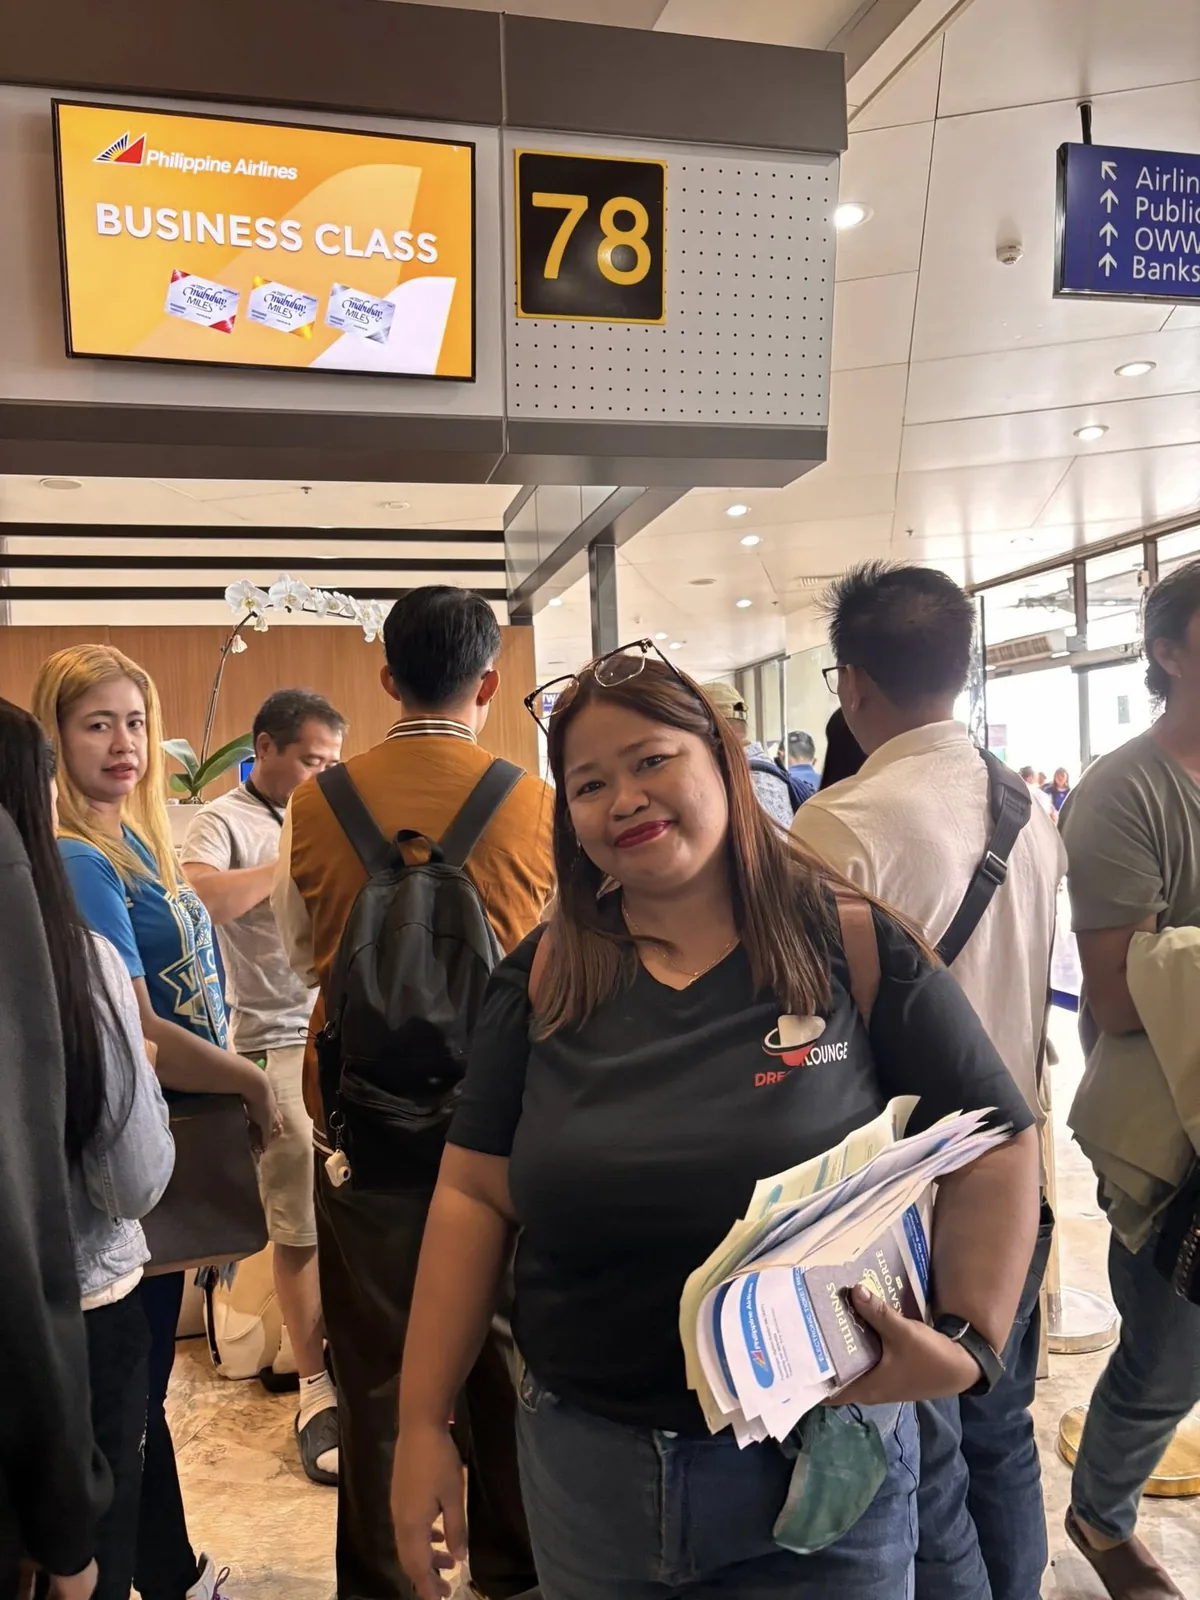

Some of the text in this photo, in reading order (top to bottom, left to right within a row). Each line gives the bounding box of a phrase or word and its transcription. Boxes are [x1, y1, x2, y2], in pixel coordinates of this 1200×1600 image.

[146, 149, 298, 180] Philippine Airlines
[96, 202, 439, 264] BUSINESS CLASS
[531, 191, 652, 286] 78
[1133, 255, 1200, 283] Banks
[186, 296, 213, 313] MILES
[267, 302, 293, 320] MILES
[345, 308, 370, 325] MILES
[804, 1041, 848, 1066] LOUNGE
[826, 1282, 857, 1355] PILIPINAS
[806, 1312, 824, 1362] ELECTRONIC
